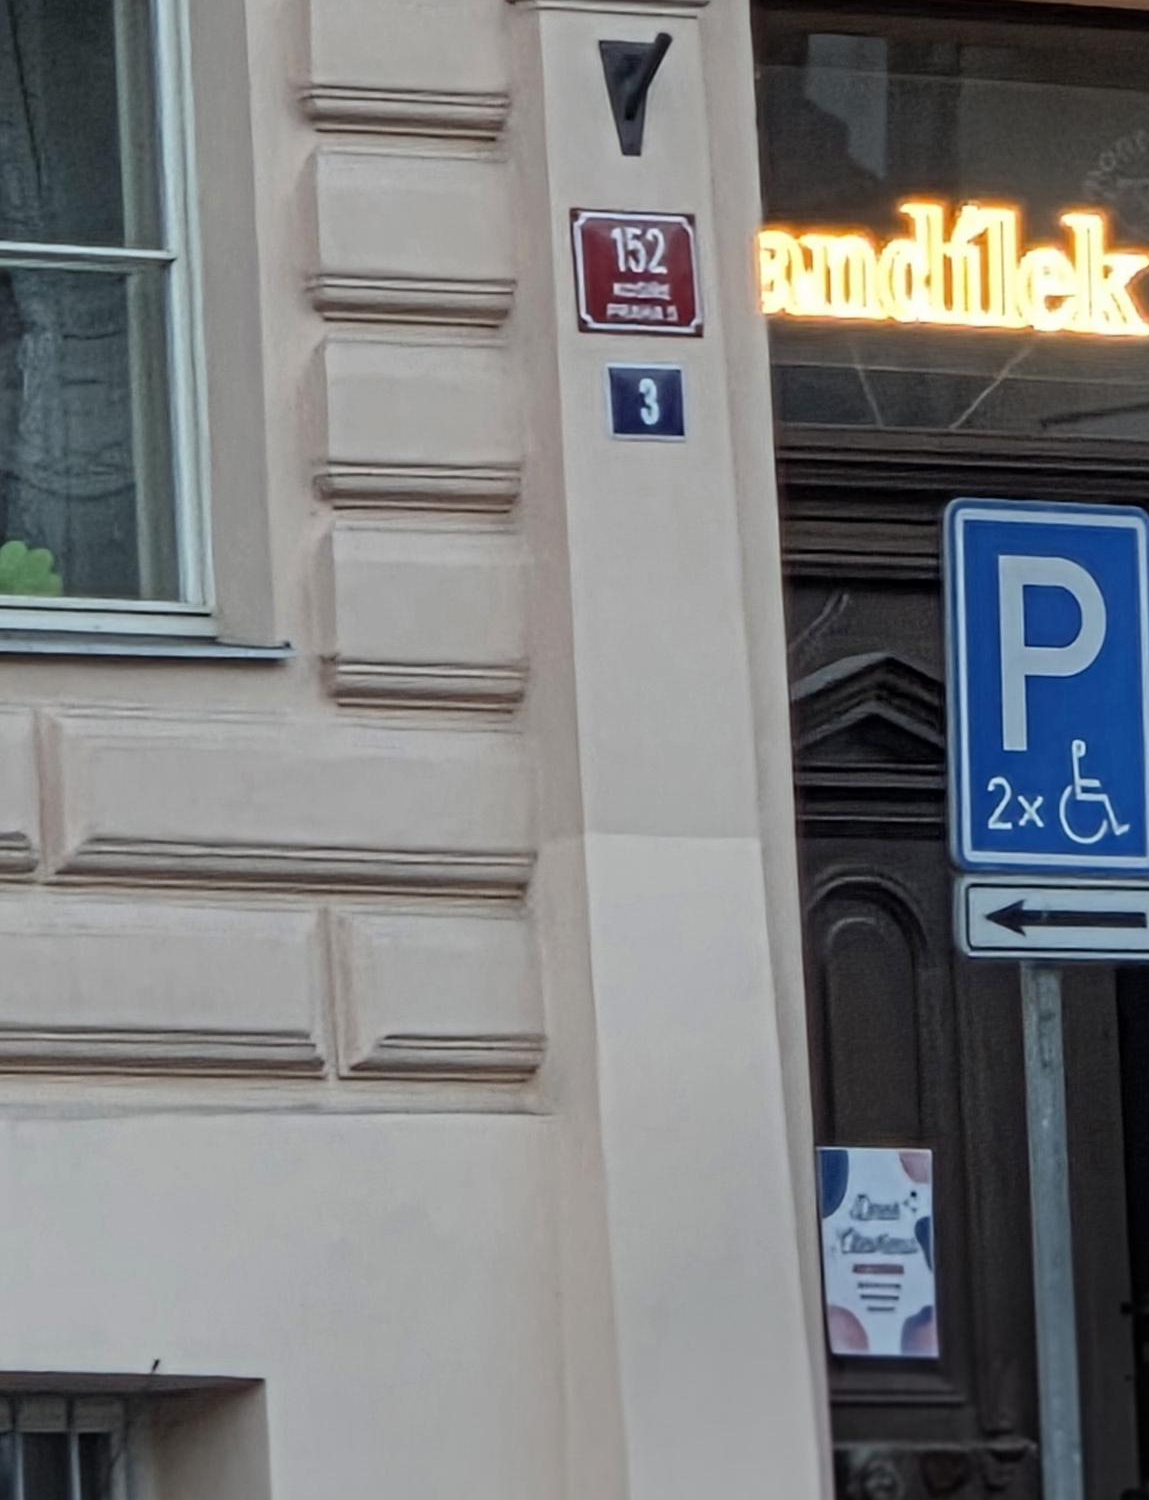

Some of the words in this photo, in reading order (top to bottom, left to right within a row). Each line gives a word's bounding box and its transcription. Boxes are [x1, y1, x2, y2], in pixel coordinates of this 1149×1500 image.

[610, 226, 668, 275] 152
[638, 377, 661, 426] 3
[998, 554, 1107, 752] P
